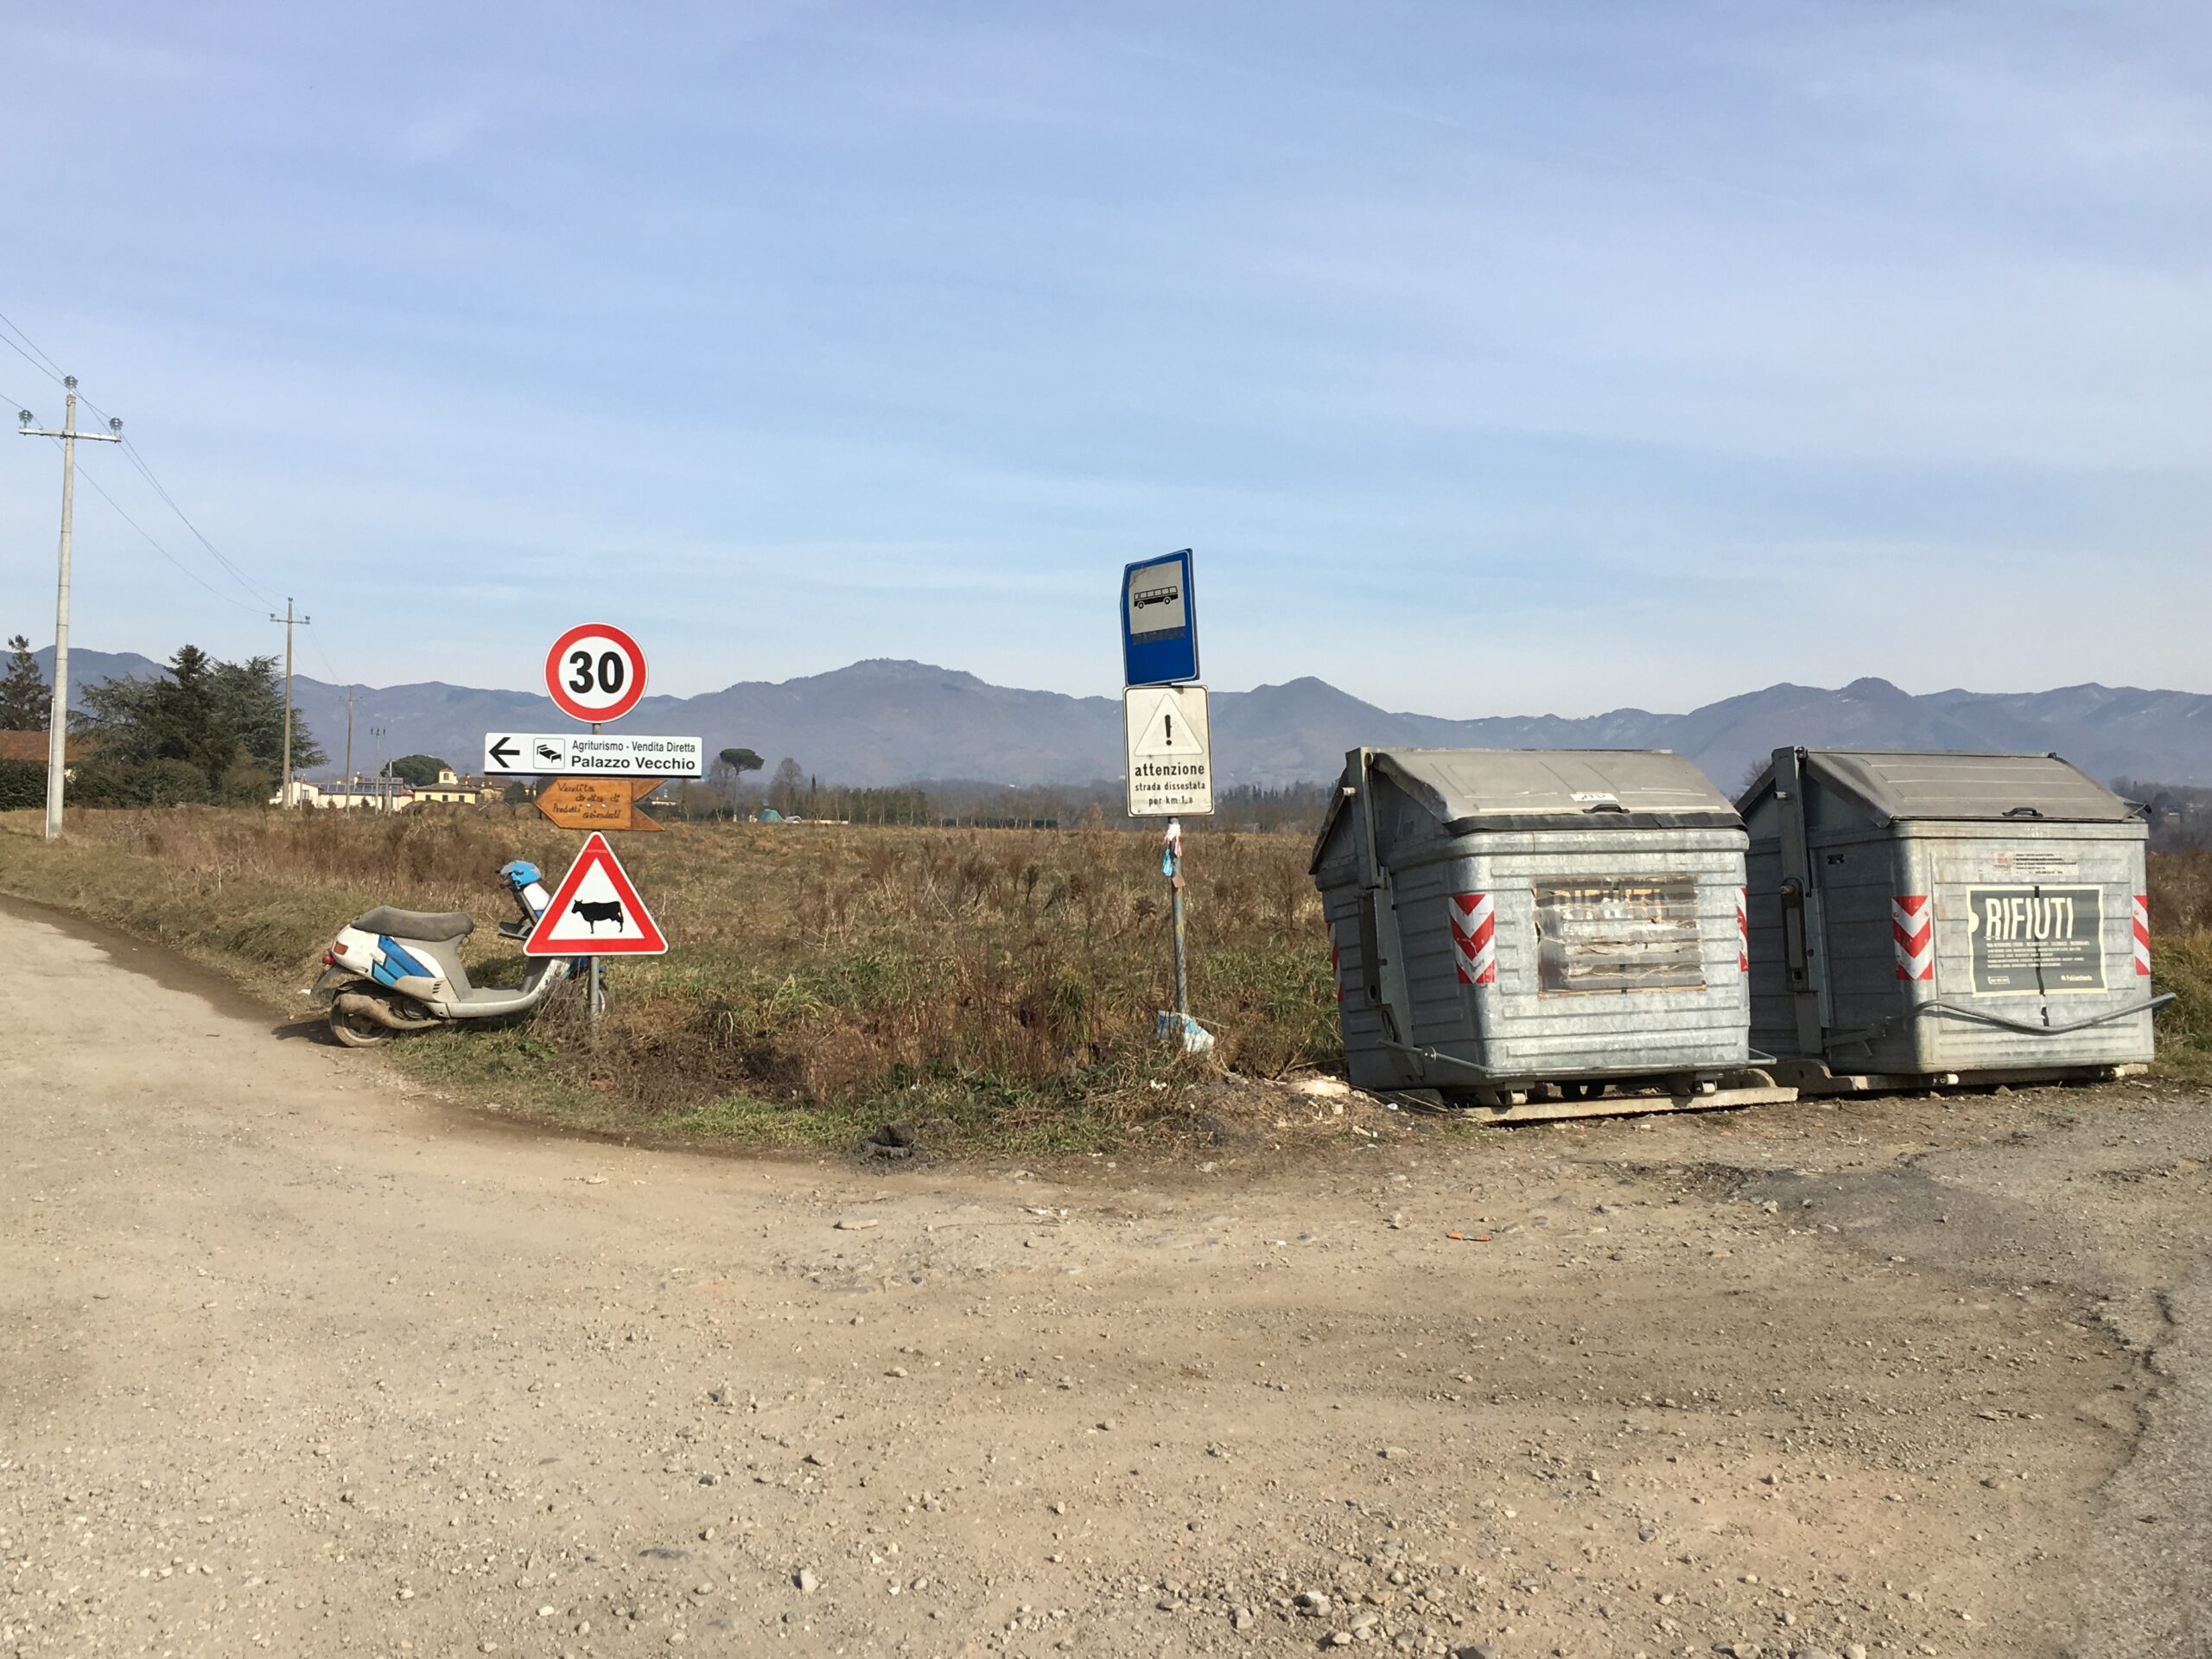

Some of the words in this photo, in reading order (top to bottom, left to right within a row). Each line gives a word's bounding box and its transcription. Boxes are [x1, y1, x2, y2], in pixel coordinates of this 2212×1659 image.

[569, 651, 625, 694] 30
[572, 740, 624, 753] Agriturismo
[632, 741, 664, 753] Vendita
[666, 741, 696, 753] Diretta
[571, 755, 630, 768] Palazzo
[635, 757, 696, 770] Vecchio
[1135, 762, 1205, 777] attenzione
[1135, 782, 1161, 791] strada
[1164, 780, 1206, 791] dissestata
[1148, 798, 1162, 807] per
[1165, 796, 1178, 804] km
[1985, 897, 2075, 941] RIFIUTI
